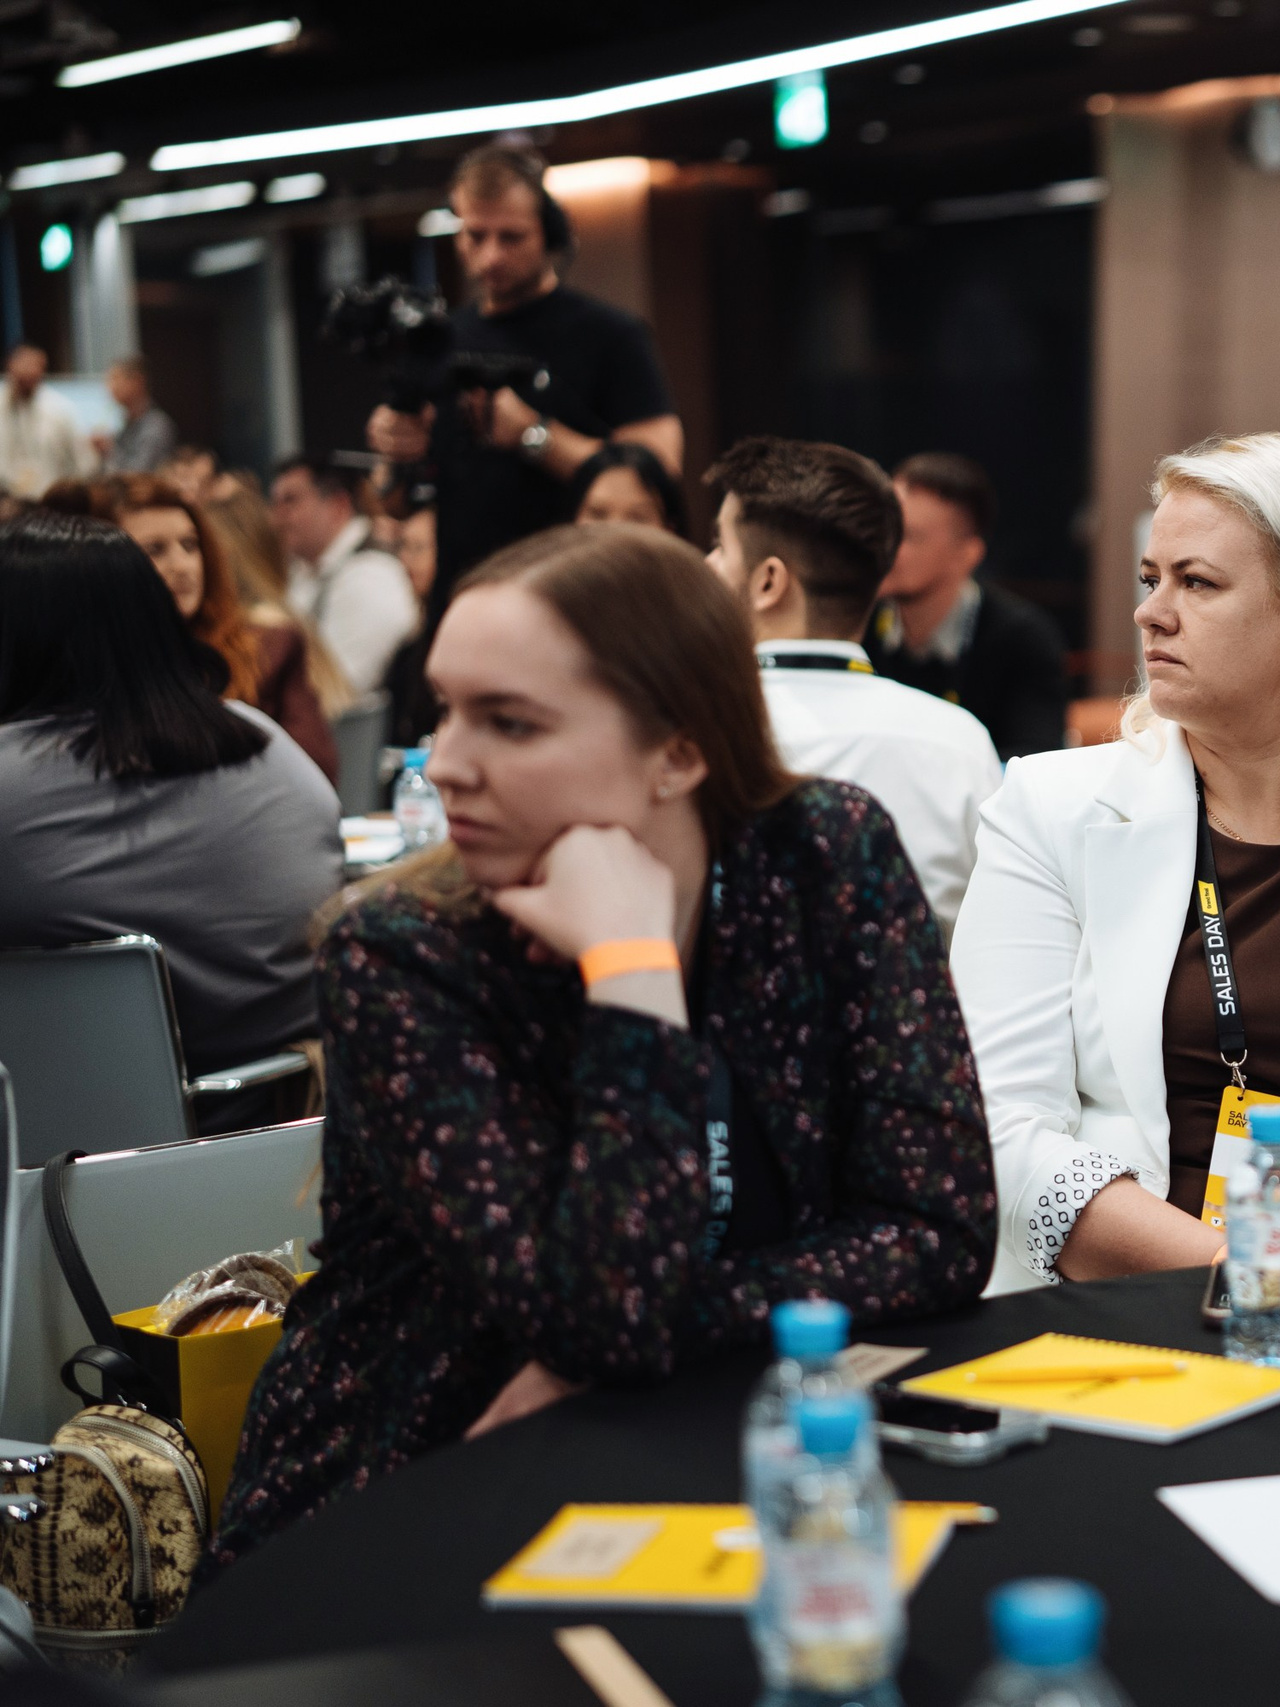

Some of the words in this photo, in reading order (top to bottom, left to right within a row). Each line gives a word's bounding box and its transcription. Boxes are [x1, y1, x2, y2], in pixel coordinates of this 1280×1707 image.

[1204, 915, 1224, 949] DAY
[1210, 953, 1236, 1016] SALES
[1228, 1118, 1248, 1128] DAY
[1229, 1110, 1248, 1121] SAL
[706, 1119, 733, 1214] SALES
[703, 1219, 729, 1260] DA
